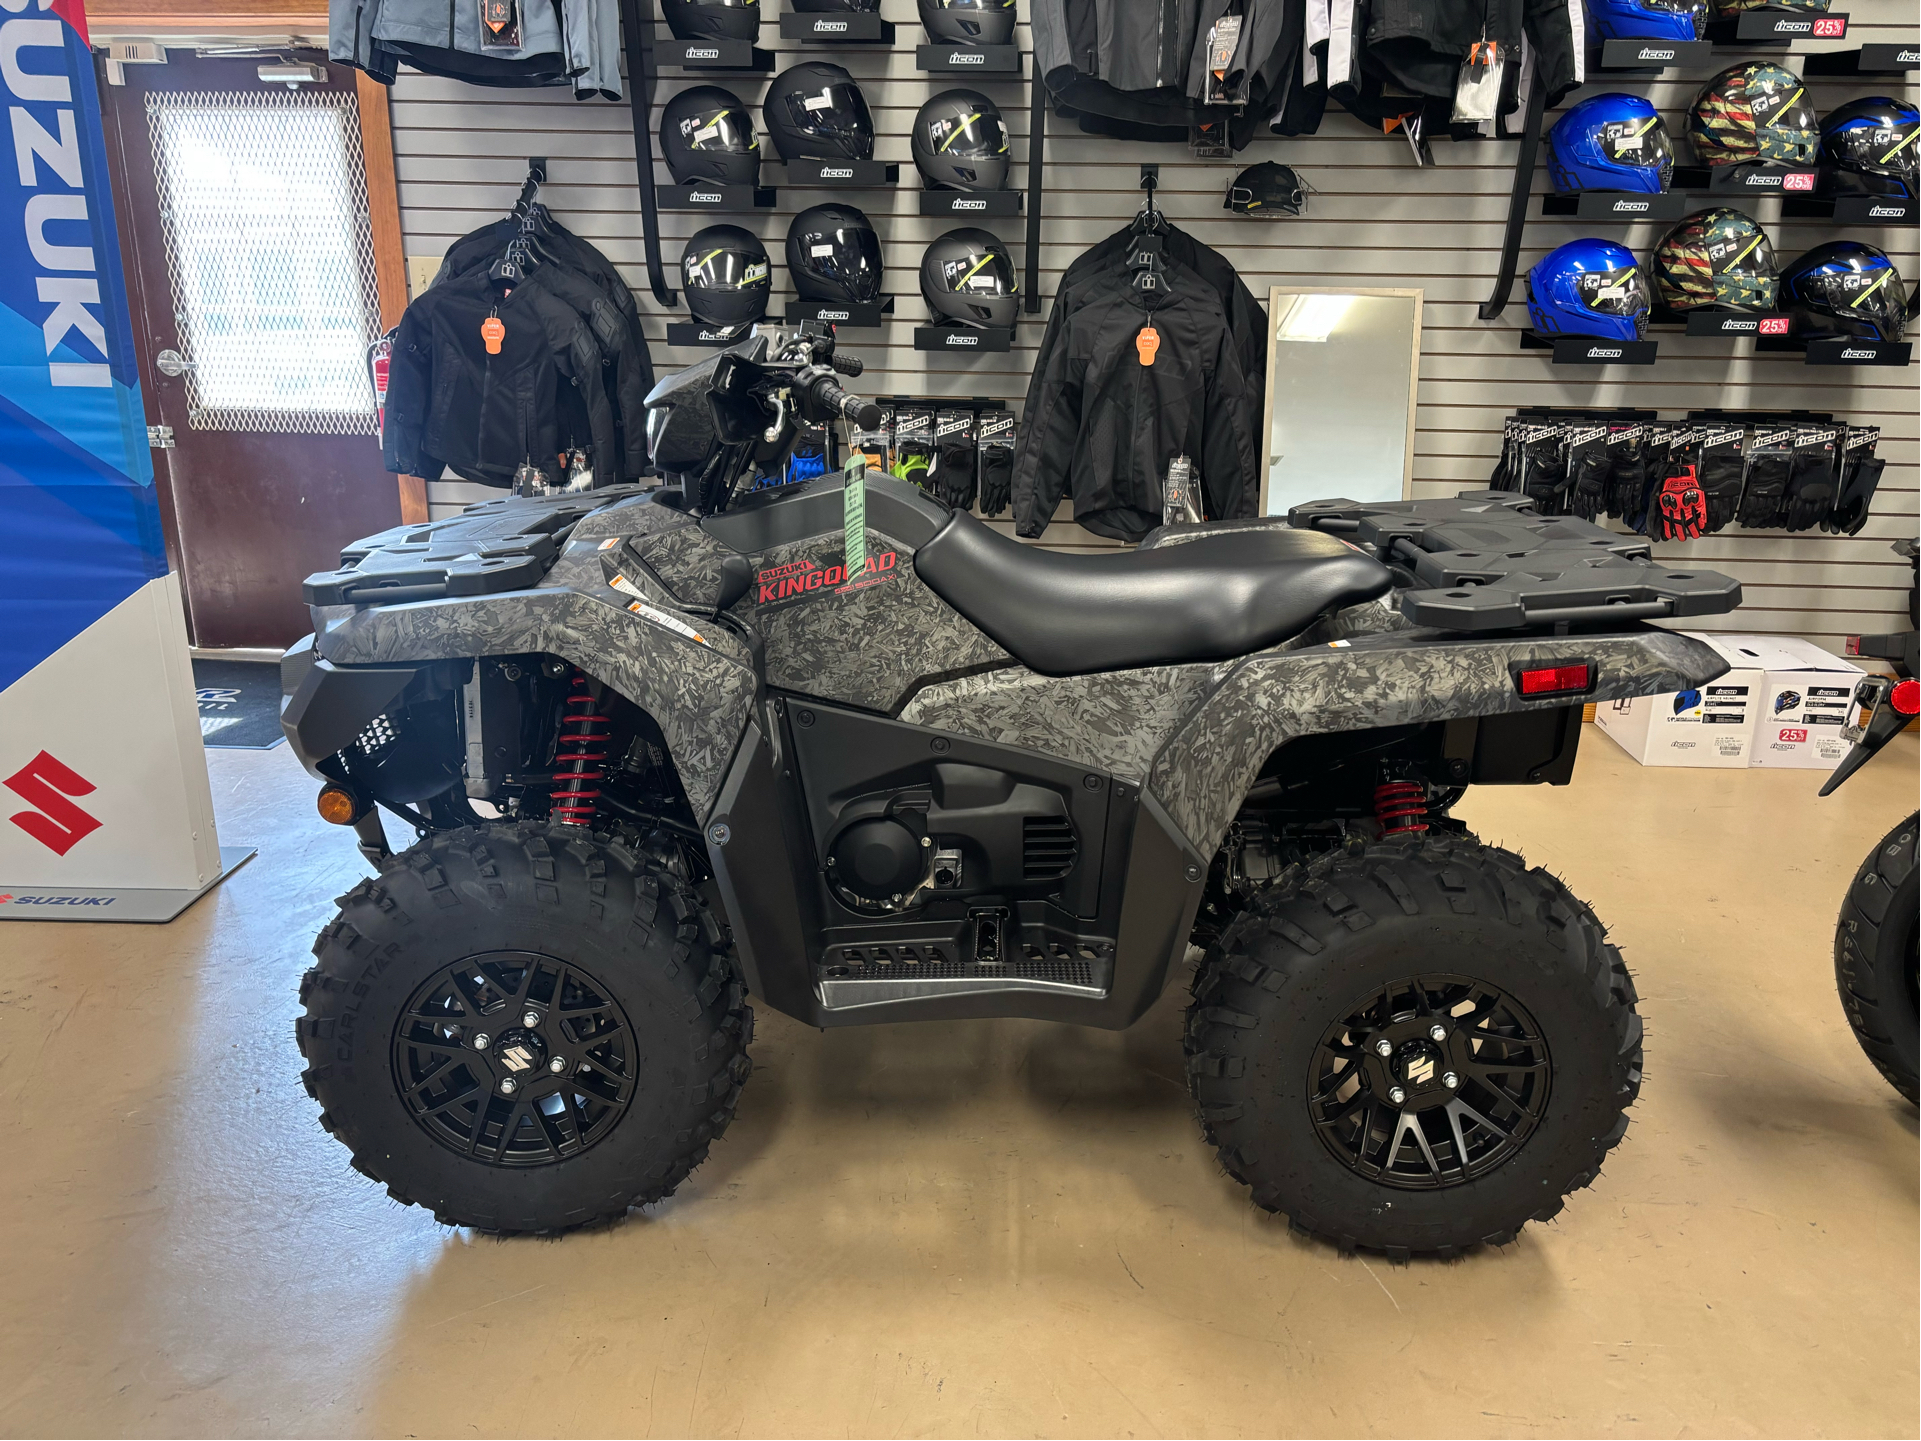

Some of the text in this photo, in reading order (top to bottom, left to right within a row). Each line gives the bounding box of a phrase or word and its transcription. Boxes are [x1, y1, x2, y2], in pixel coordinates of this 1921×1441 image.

[1816, 21, 1841, 35] 25%
[1786, 175, 1811, 188] 25%
[0, 0, 113, 388] UZUKI
[1761, 320, 1786, 333] 25%
[760, 561, 808, 581] SUZUKI
[1781, 731, 1804, 741] 25%
[14, 896, 116, 906] SUZUKI
[337, 941, 404, 1062] CARLSTAR
